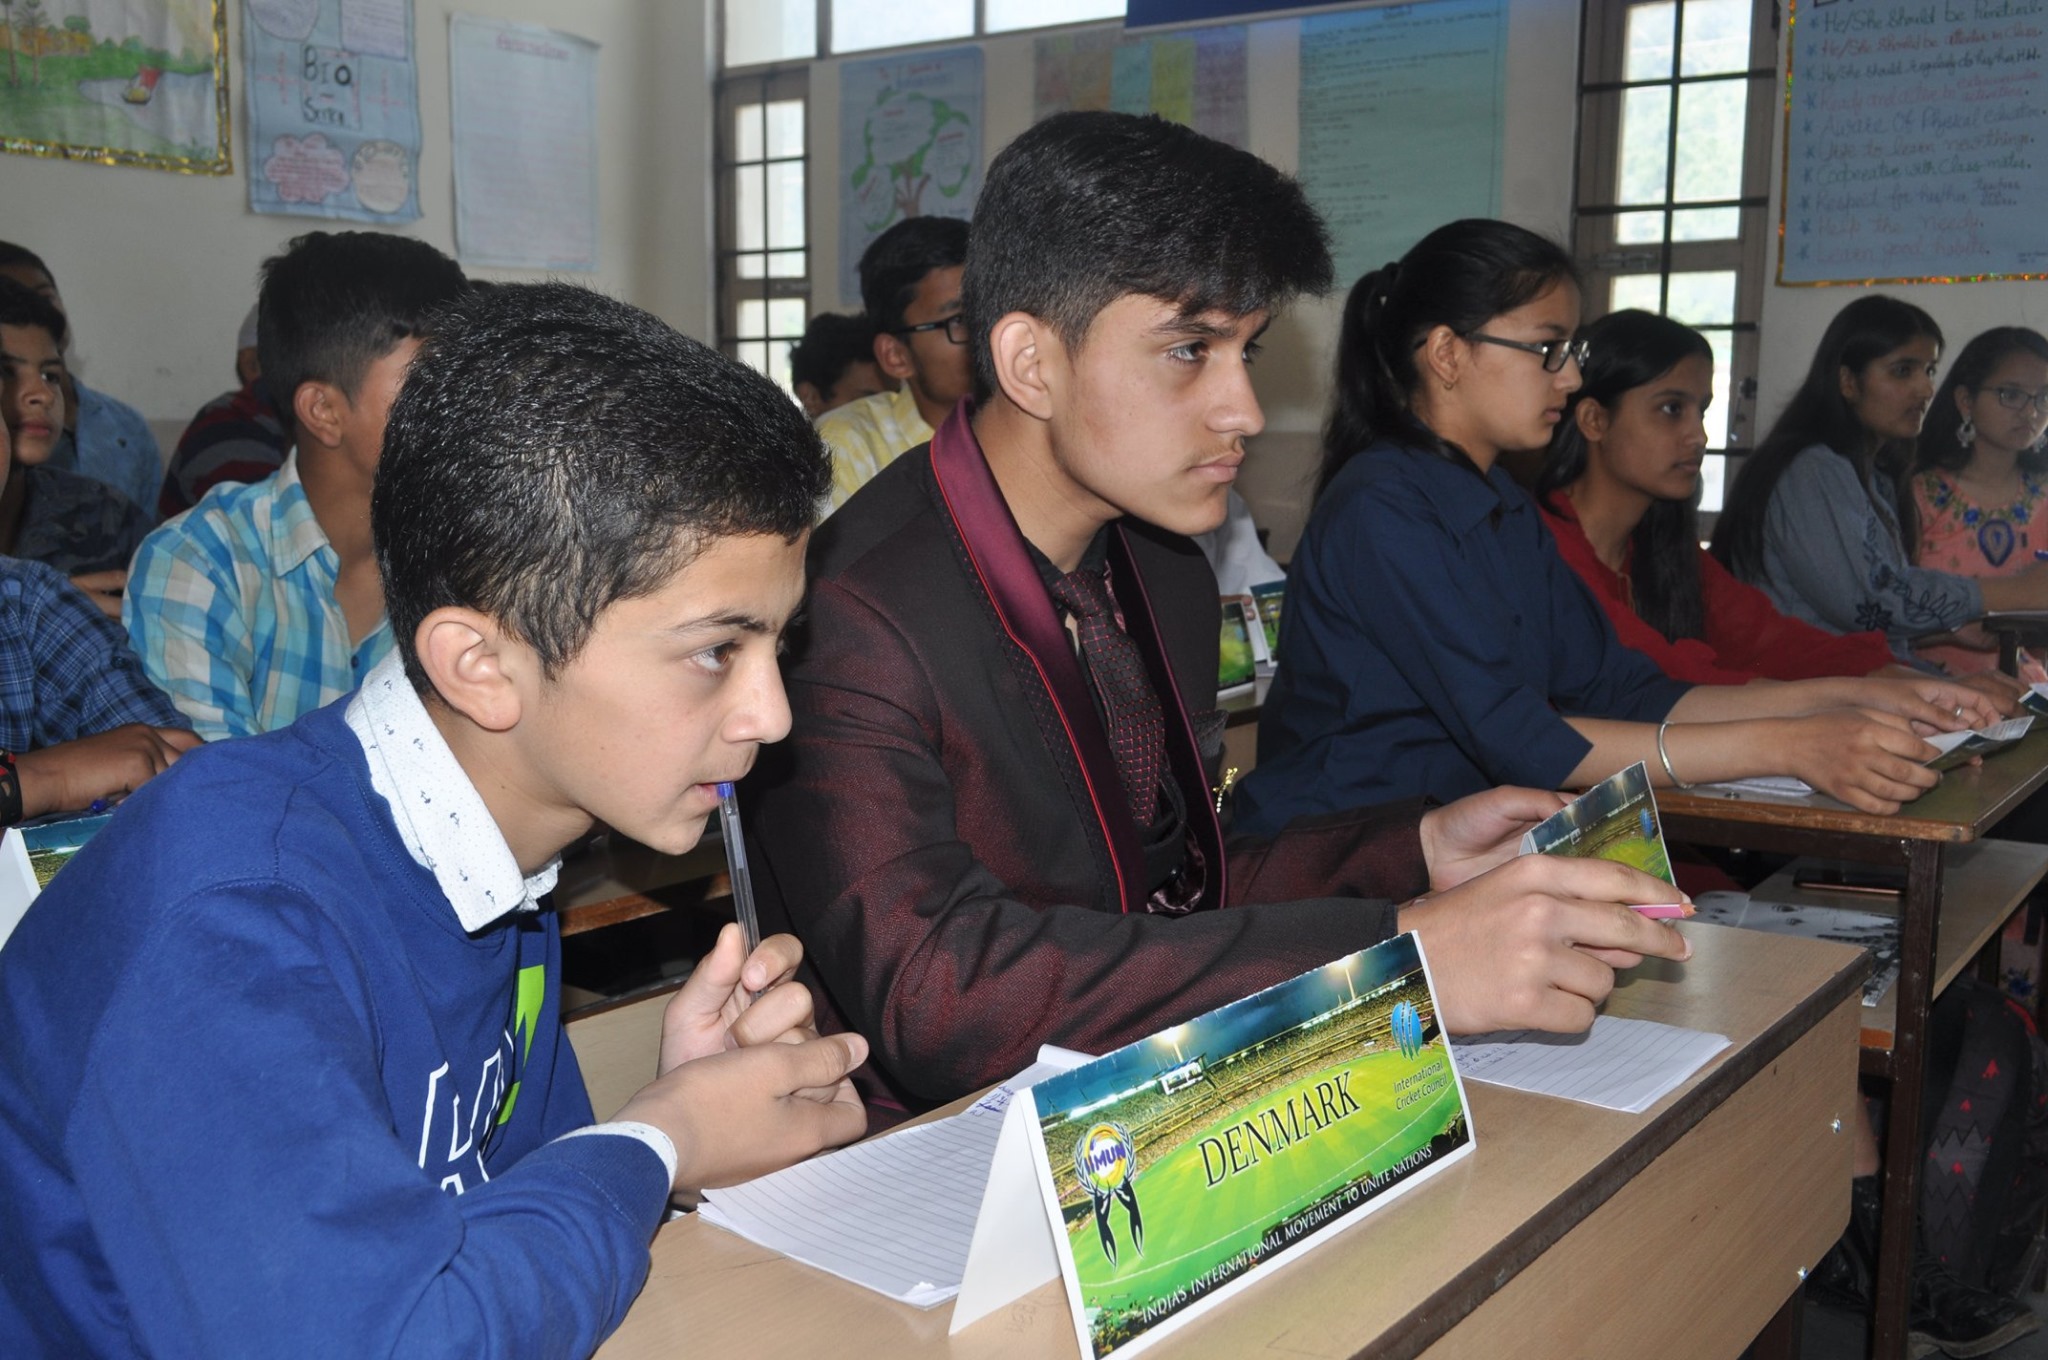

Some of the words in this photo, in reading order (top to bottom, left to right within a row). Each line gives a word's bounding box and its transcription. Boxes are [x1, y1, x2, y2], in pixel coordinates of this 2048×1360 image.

[1393, 1058, 1444, 1094] International
[1395, 1087, 1422, 1112] Cricket
[1421, 1074, 1448, 1097] Council
[1197, 1070, 1362, 1188] DENMARK
[1141, 1284, 1188, 1324] INDIA'S
[1190, 1231, 1283, 1296] INTERNATIONAL
[1284, 1196, 1344, 1241] MOVEMENT
[1344, 1187, 1360, 1205] TO
[1361, 1168, 1392, 1196] UNITE
[1392, 1143, 1433, 1177] NATIONS
